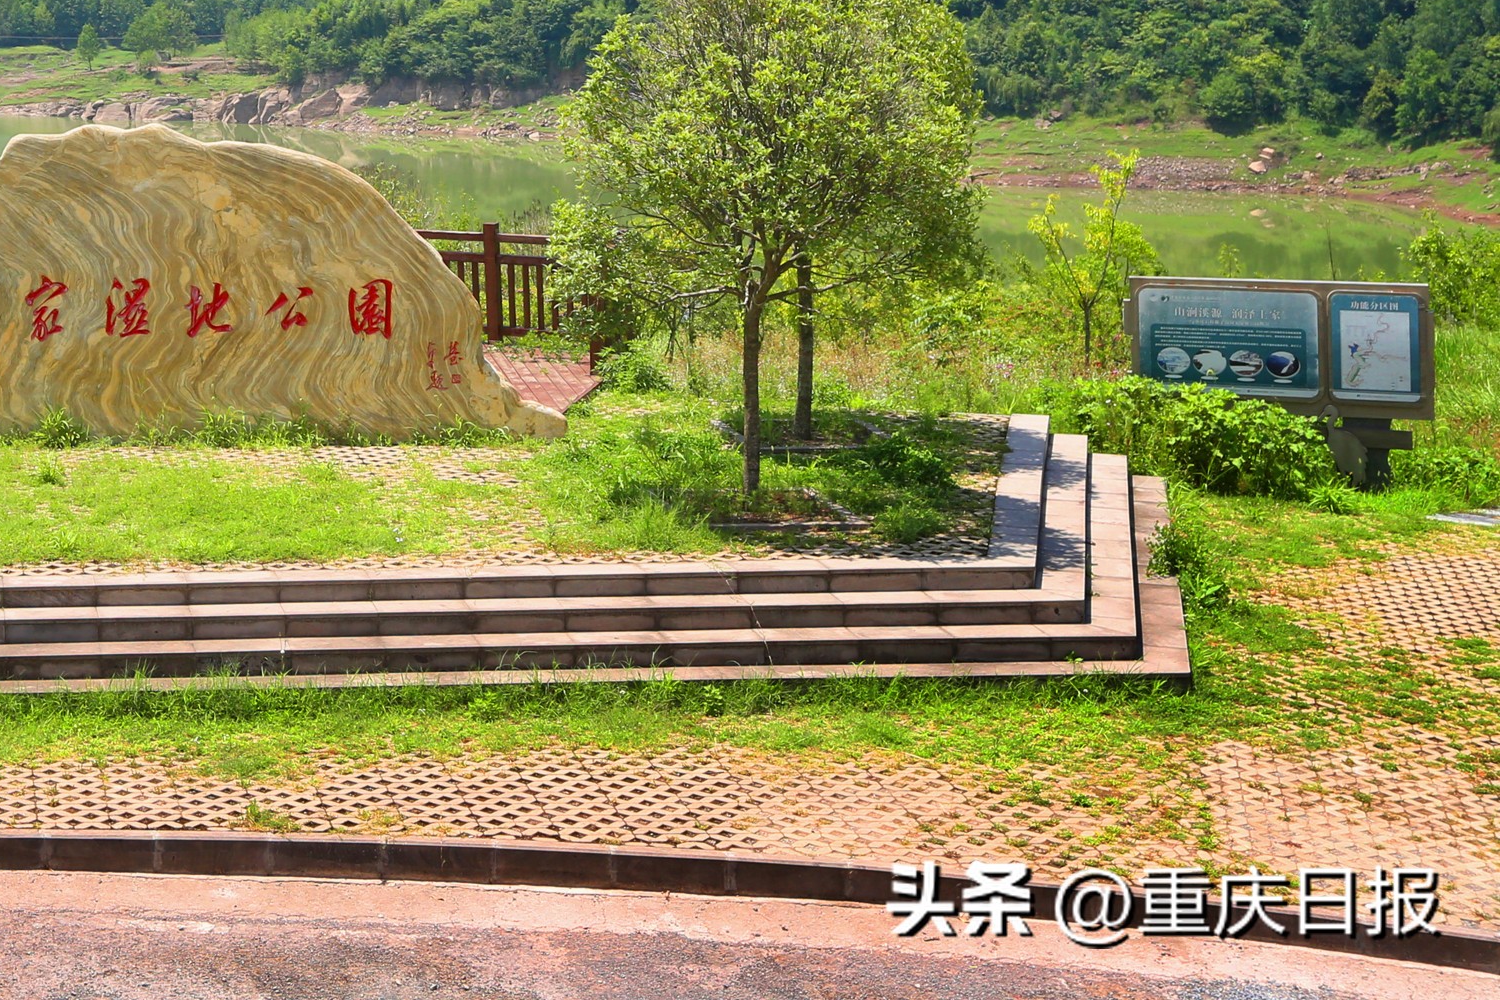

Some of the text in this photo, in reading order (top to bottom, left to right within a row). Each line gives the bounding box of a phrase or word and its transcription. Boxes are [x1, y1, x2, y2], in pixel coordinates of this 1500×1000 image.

[1350, 301, 1399, 311] 功能分区图
